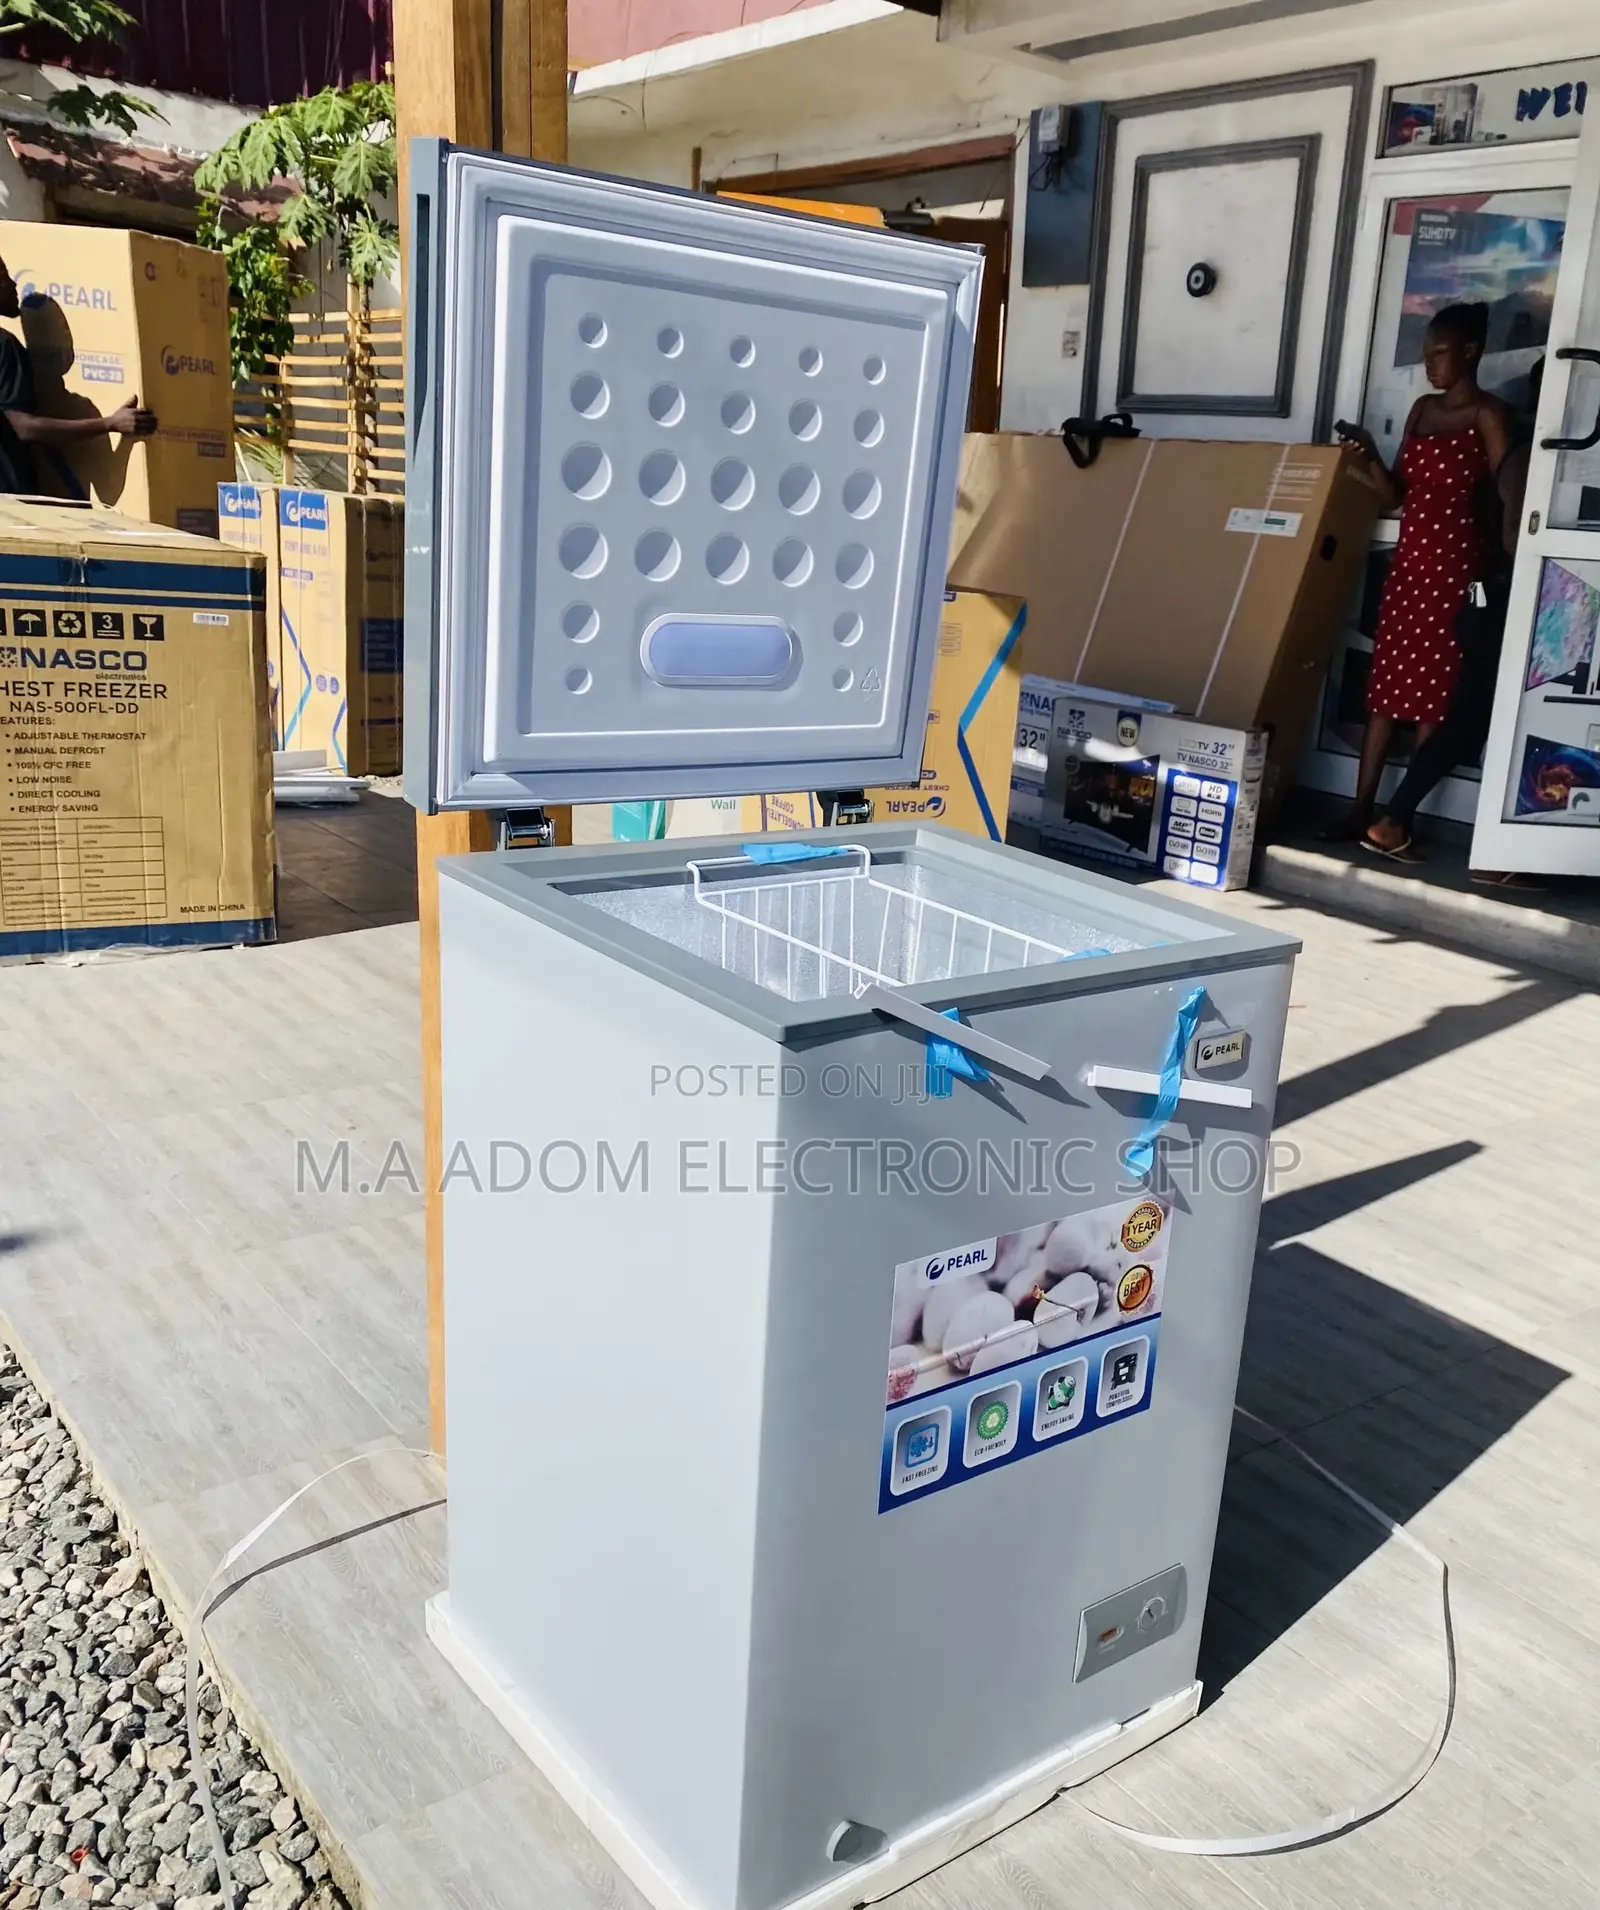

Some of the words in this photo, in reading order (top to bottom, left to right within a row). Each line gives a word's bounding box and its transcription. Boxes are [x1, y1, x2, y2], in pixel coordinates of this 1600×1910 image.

[48, 282, 117, 311] PEARL
[180, 355, 219, 376] PEARL
[300, 506, 328, 522] PEARL
[20, 647, 147, 671] NASCO
[95, 672, 147, 682] electronics
[64, 682, 168, 699] FREEZER
[10, 701, 139, 714] NAS-500FL-DD
[1030, 693, 1052, 712] NA
[14, 732, 80, 740] ADJUSTABLE
[82, 732, 147, 740] THERMOSTAT
[1056, 726, 1093, 740] NASCO
[1119, 727, 1136, 739] NEW
[14, 746, 57, 755] MANUAL
[60, 747, 105, 755] DEFROST
[43, 761, 63, 769] CFC
[66, 761, 91, 769] FREE
[1176, 752, 1188, 762] TV
[1188, 755, 1218, 767] NASCO
[16, 776, 40, 784] LOW
[42, 776, 73, 784] NOISE
[18, 790, 54, 798] DIRECT
[56, 790, 101, 798] COOLING
[924, 784, 950, 792] CHEST
[1208, 784, 1223, 794] HD
[19, 804, 60, 813] ENERGY
[62, 804, 99, 812] SAVING
[711, 799, 736, 810] Wall
[886, 800, 925, 813] PEARL
[180, 905, 206, 913] MADE
[218, 904, 246, 912] CHINA
[1215, 1041, 1240, 1056] PEARL
[1132, 1218, 1157, 1235] YEAR
[947, 1249, 988, 1271] PEARL
[1123, 1278, 1146, 1298] BEST
[901, 1473, 915, 1484] FAST
